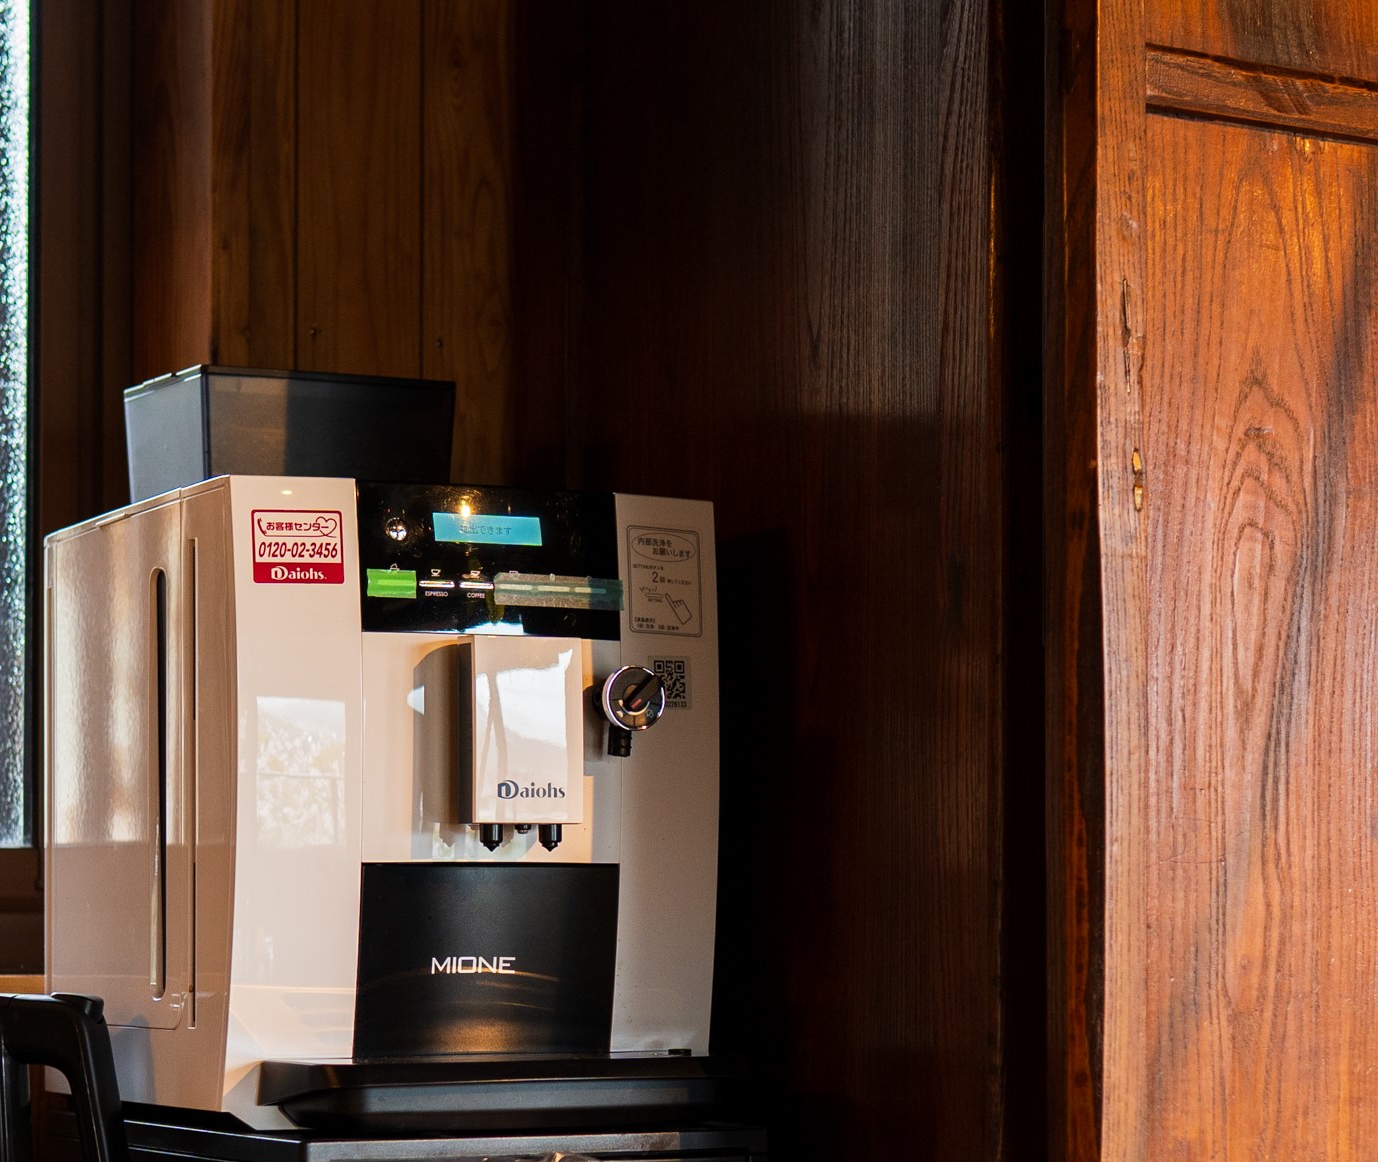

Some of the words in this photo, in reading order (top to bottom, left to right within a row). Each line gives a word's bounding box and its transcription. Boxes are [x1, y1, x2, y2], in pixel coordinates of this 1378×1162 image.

[266, 521, 330, 532] お客様センター
[258, 541, 338, 559] 0120-02-3456
[270, 565, 325, 581] Daiohs
[425, 590, 449, 598] ESPRESSO
[497, 779, 566, 800] Daiohs
[430, 956, 517, 975] MIONE
